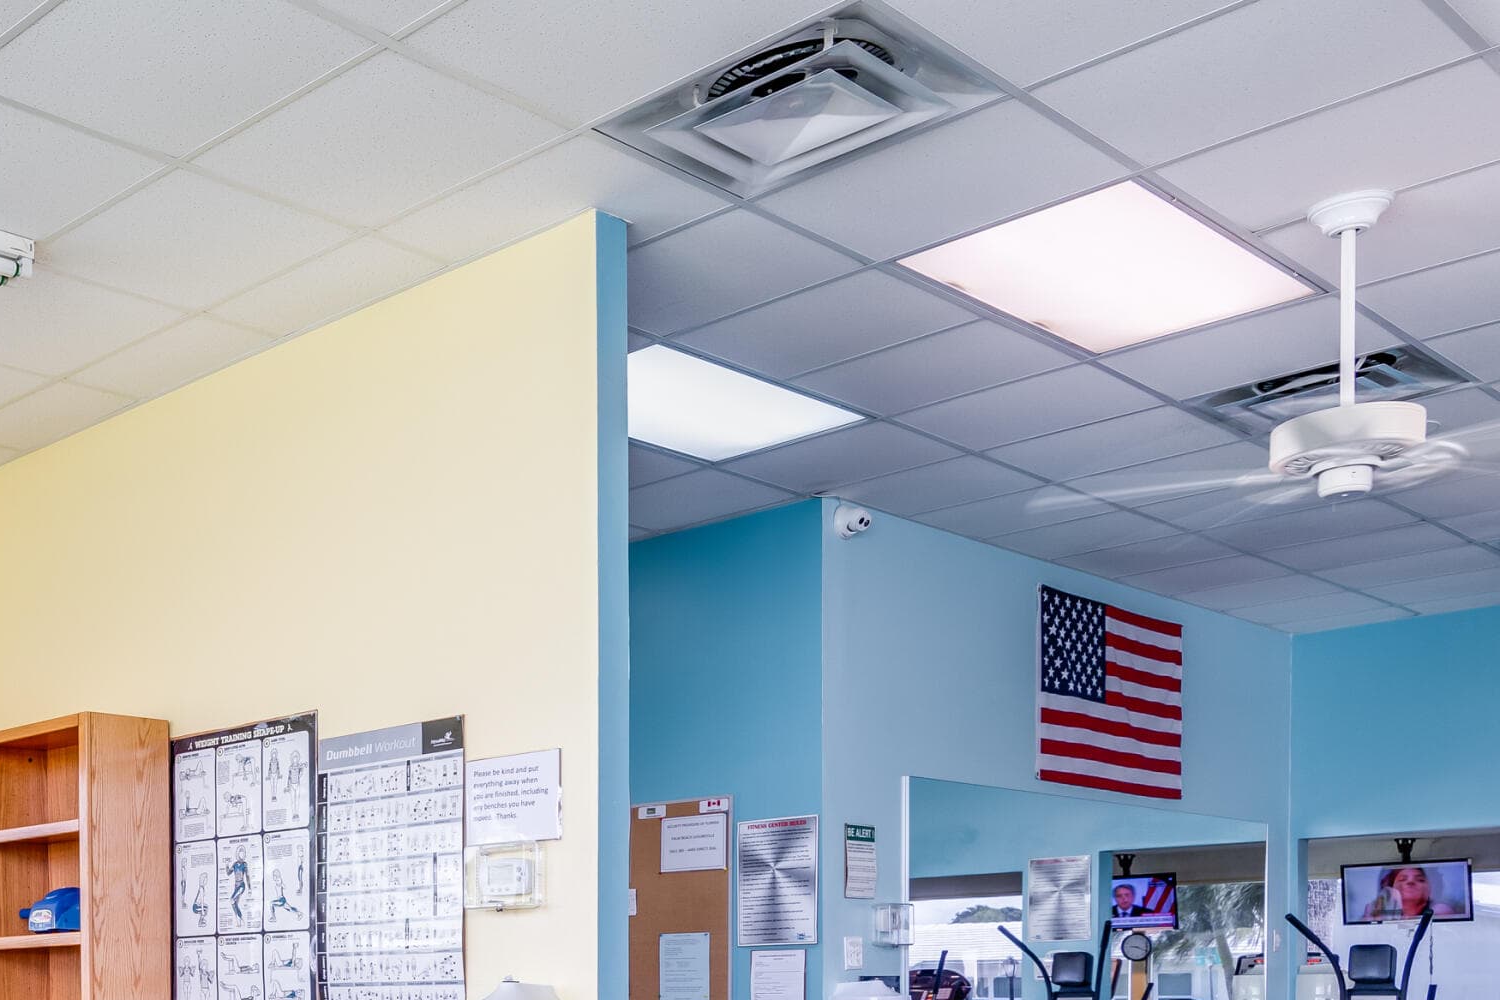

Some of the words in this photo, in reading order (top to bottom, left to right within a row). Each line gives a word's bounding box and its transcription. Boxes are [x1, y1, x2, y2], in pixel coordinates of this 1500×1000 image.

[195, 738, 219, 749] WEIGHT
[220, 732, 252, 745] TRAINING
[253, 724, 285, 738] SHAPE-UP
[326, 744, 373, 761] Dumbbell
[374, 737, 417, 753] Workout
[473, 770, 491, 778] Please
[515, 766, 527, 774] and
[473, 780, 503, 789] everything
[521, 787, 548, 795] including
[484, 802, 507, 810] benches
[848, 828, 855, 837] BE
[856, 828, 871, 838] ALERT
